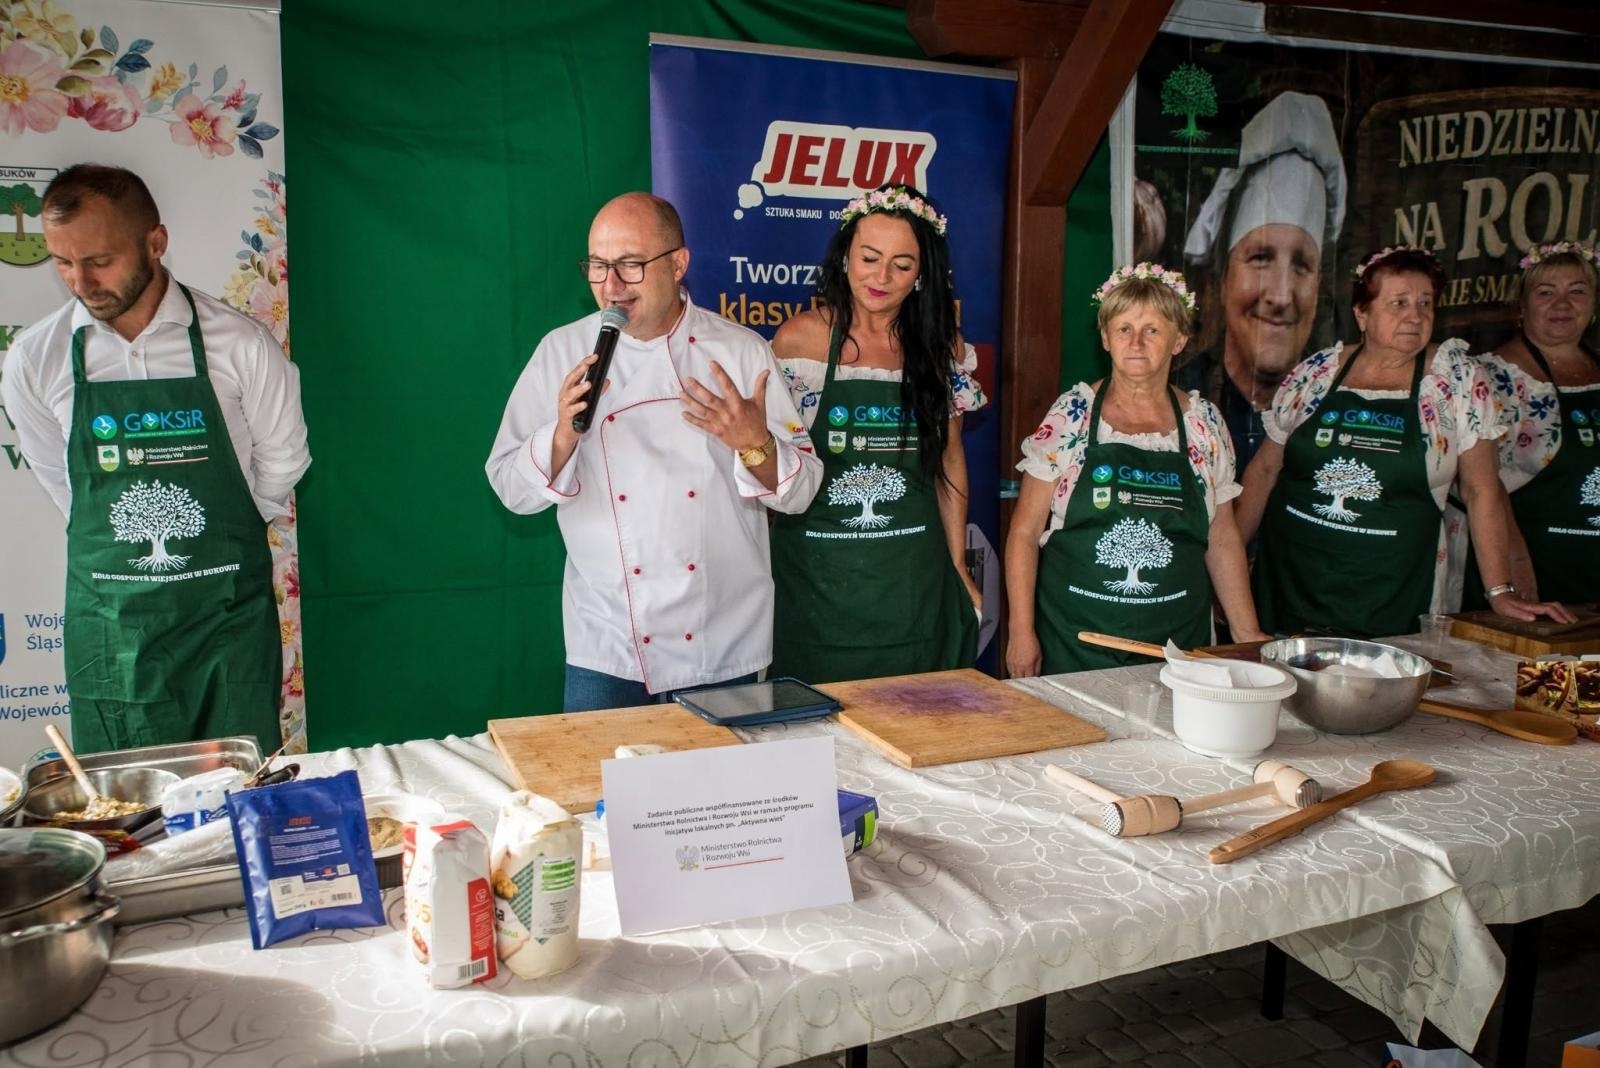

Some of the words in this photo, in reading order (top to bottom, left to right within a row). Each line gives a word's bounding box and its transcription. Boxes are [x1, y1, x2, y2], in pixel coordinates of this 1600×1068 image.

[1398, 107, 1600, 168] NIEDZIELN
[763, 133, 926, 189] JELUX
[765, 207, 794, 218] SZTUKA
[795, 208, 822, 219] SMAKU
[1394, 201, 1446, 250] NA
[150, 572, 193, 583] WIEJSKICH
[203, 563, 240, 576] BUKOWIE
[633, 820, 675, 830] Ministerstwa
[676, 816, 707, 824] Rolnictwa
[712, 812, 739, 821] Rozwoju
[740, 808, 752, 816] Wsi
[760, 806, 782, 814] ramach
[783, 803, 814, 813] programu
[647, 809, 672, 818] Zadanie
[674, 806, 704, 816] publiczne
[694, 822, 724, 832] lokalnych
[701, 840, 747, 852] Ministerstwo
[748, 837, 782, 846] Rolnictwa
[706, 852, 736, 862] Rozwoju
